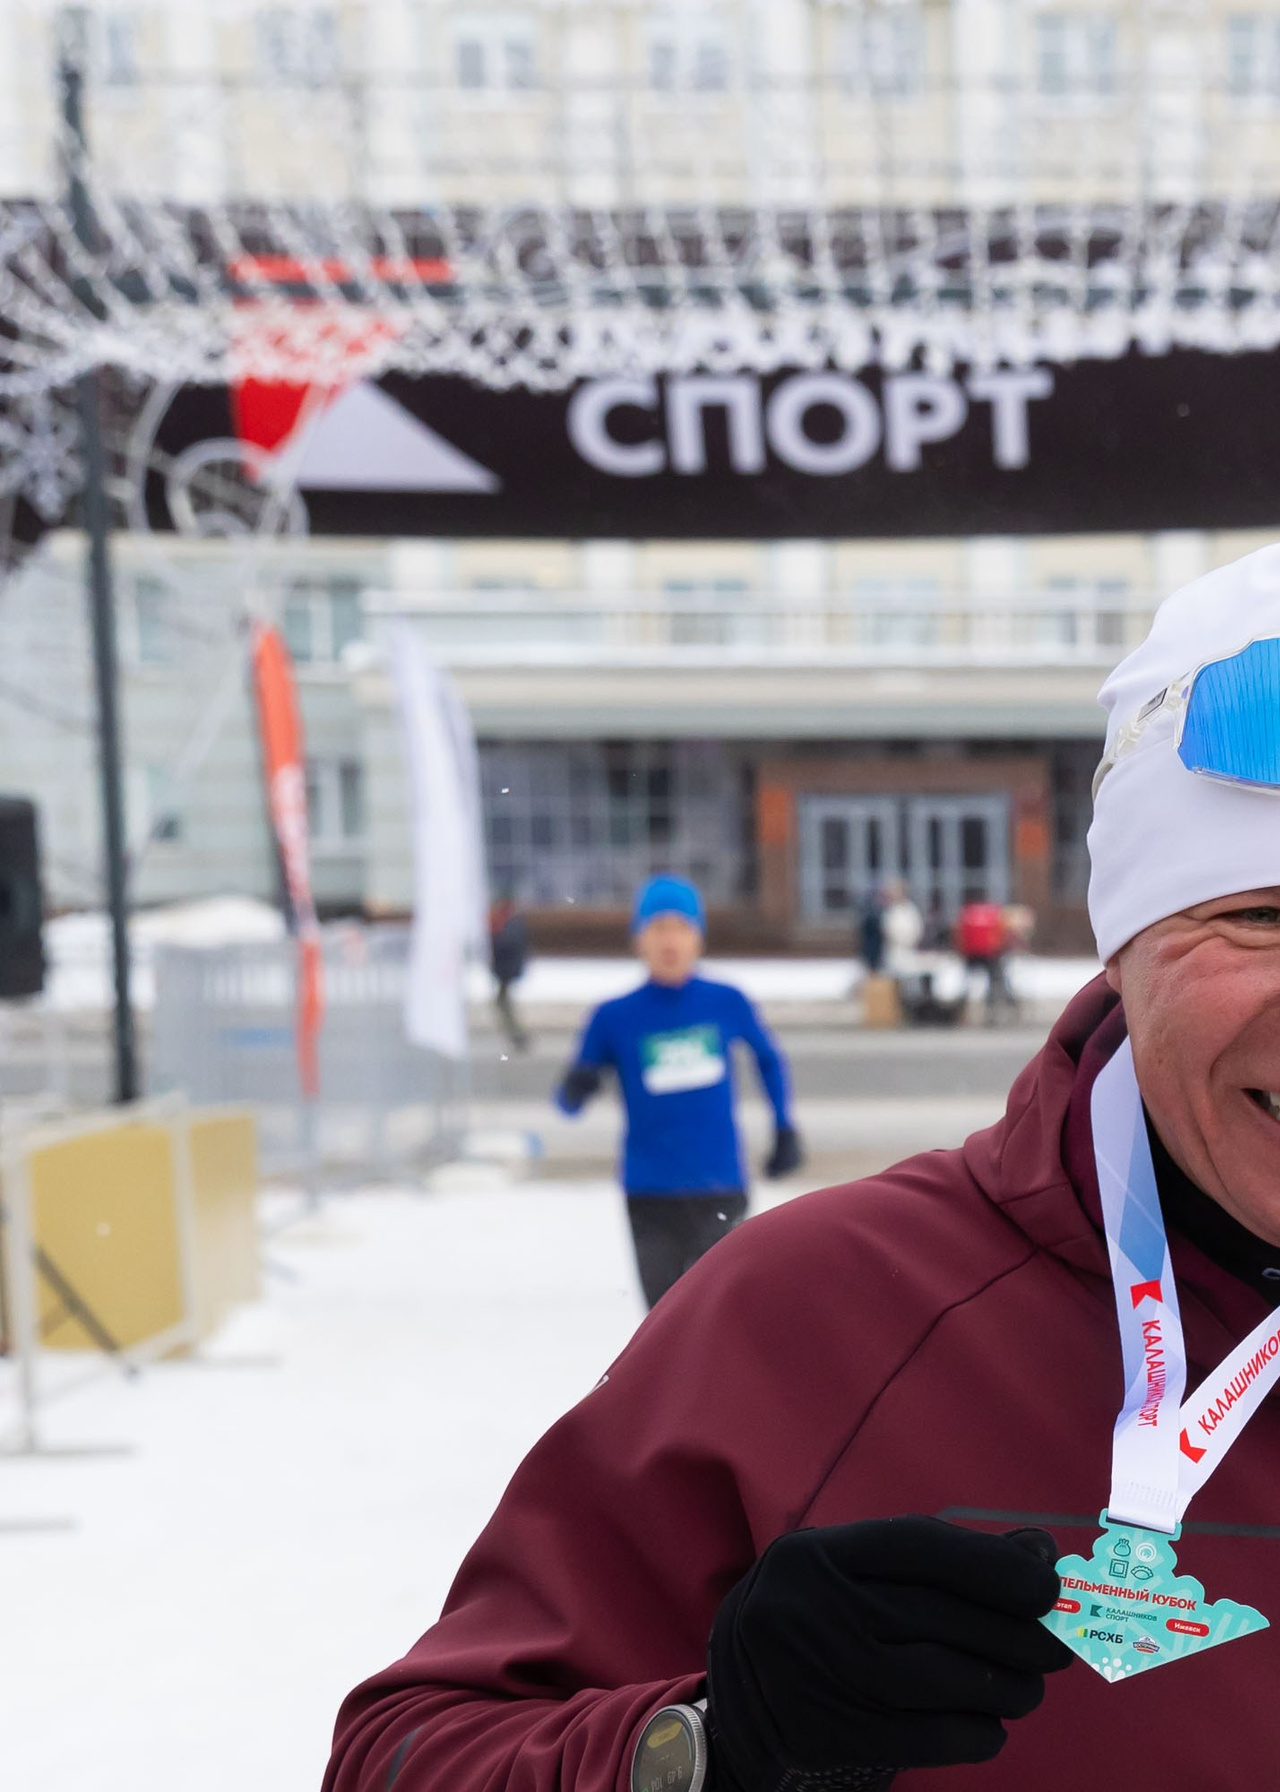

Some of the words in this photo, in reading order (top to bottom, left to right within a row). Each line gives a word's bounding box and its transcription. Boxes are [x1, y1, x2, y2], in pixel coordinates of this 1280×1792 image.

[567, 370, 1054, 477] СПОРТ
[1059, 1576, 1150, 1602] ПЕЛЬМЕННЫЙ
[1152, 1594, 1197, 1611] КУБОК
[1105, 1607, 1158, 1622] КАЛАШНИКОВ
[1105, 1613, 1129, 1623] СПОРТ
[1173, 1621, 1202, 1633] Ижевск
[1089, 1630, 1124, 1644] РСХБ
